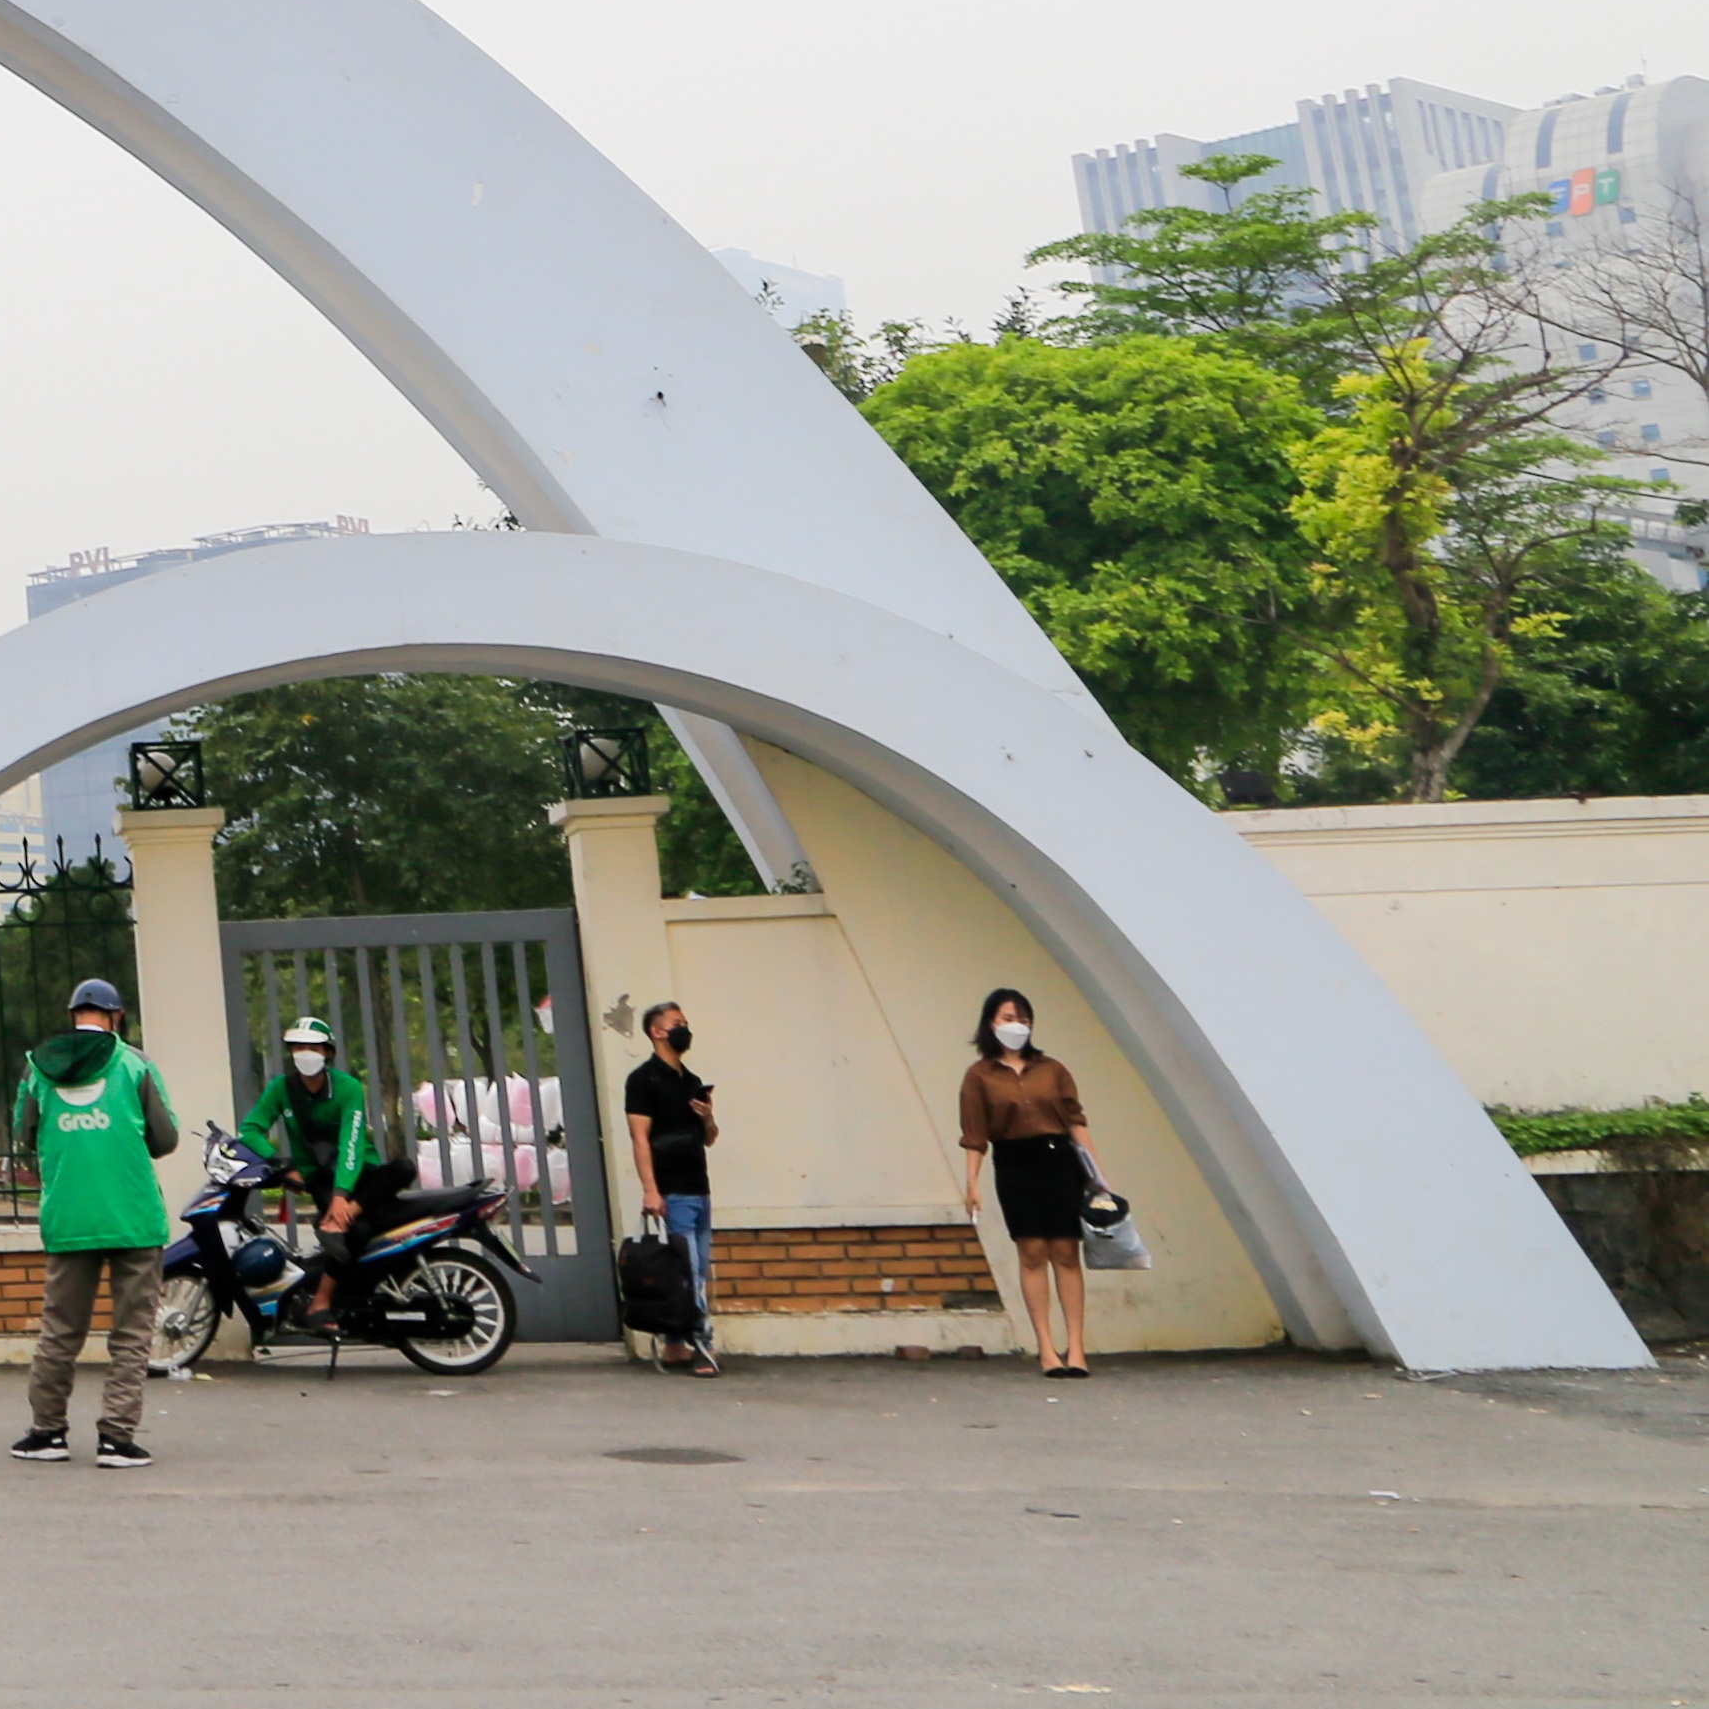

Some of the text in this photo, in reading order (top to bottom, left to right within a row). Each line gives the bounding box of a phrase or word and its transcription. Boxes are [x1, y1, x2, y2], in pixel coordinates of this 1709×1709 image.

[1549, 172, 1618, 206] FPT
[69, 547, 111, 577] PVI
[58, 1108, 111, 1132] Grab
